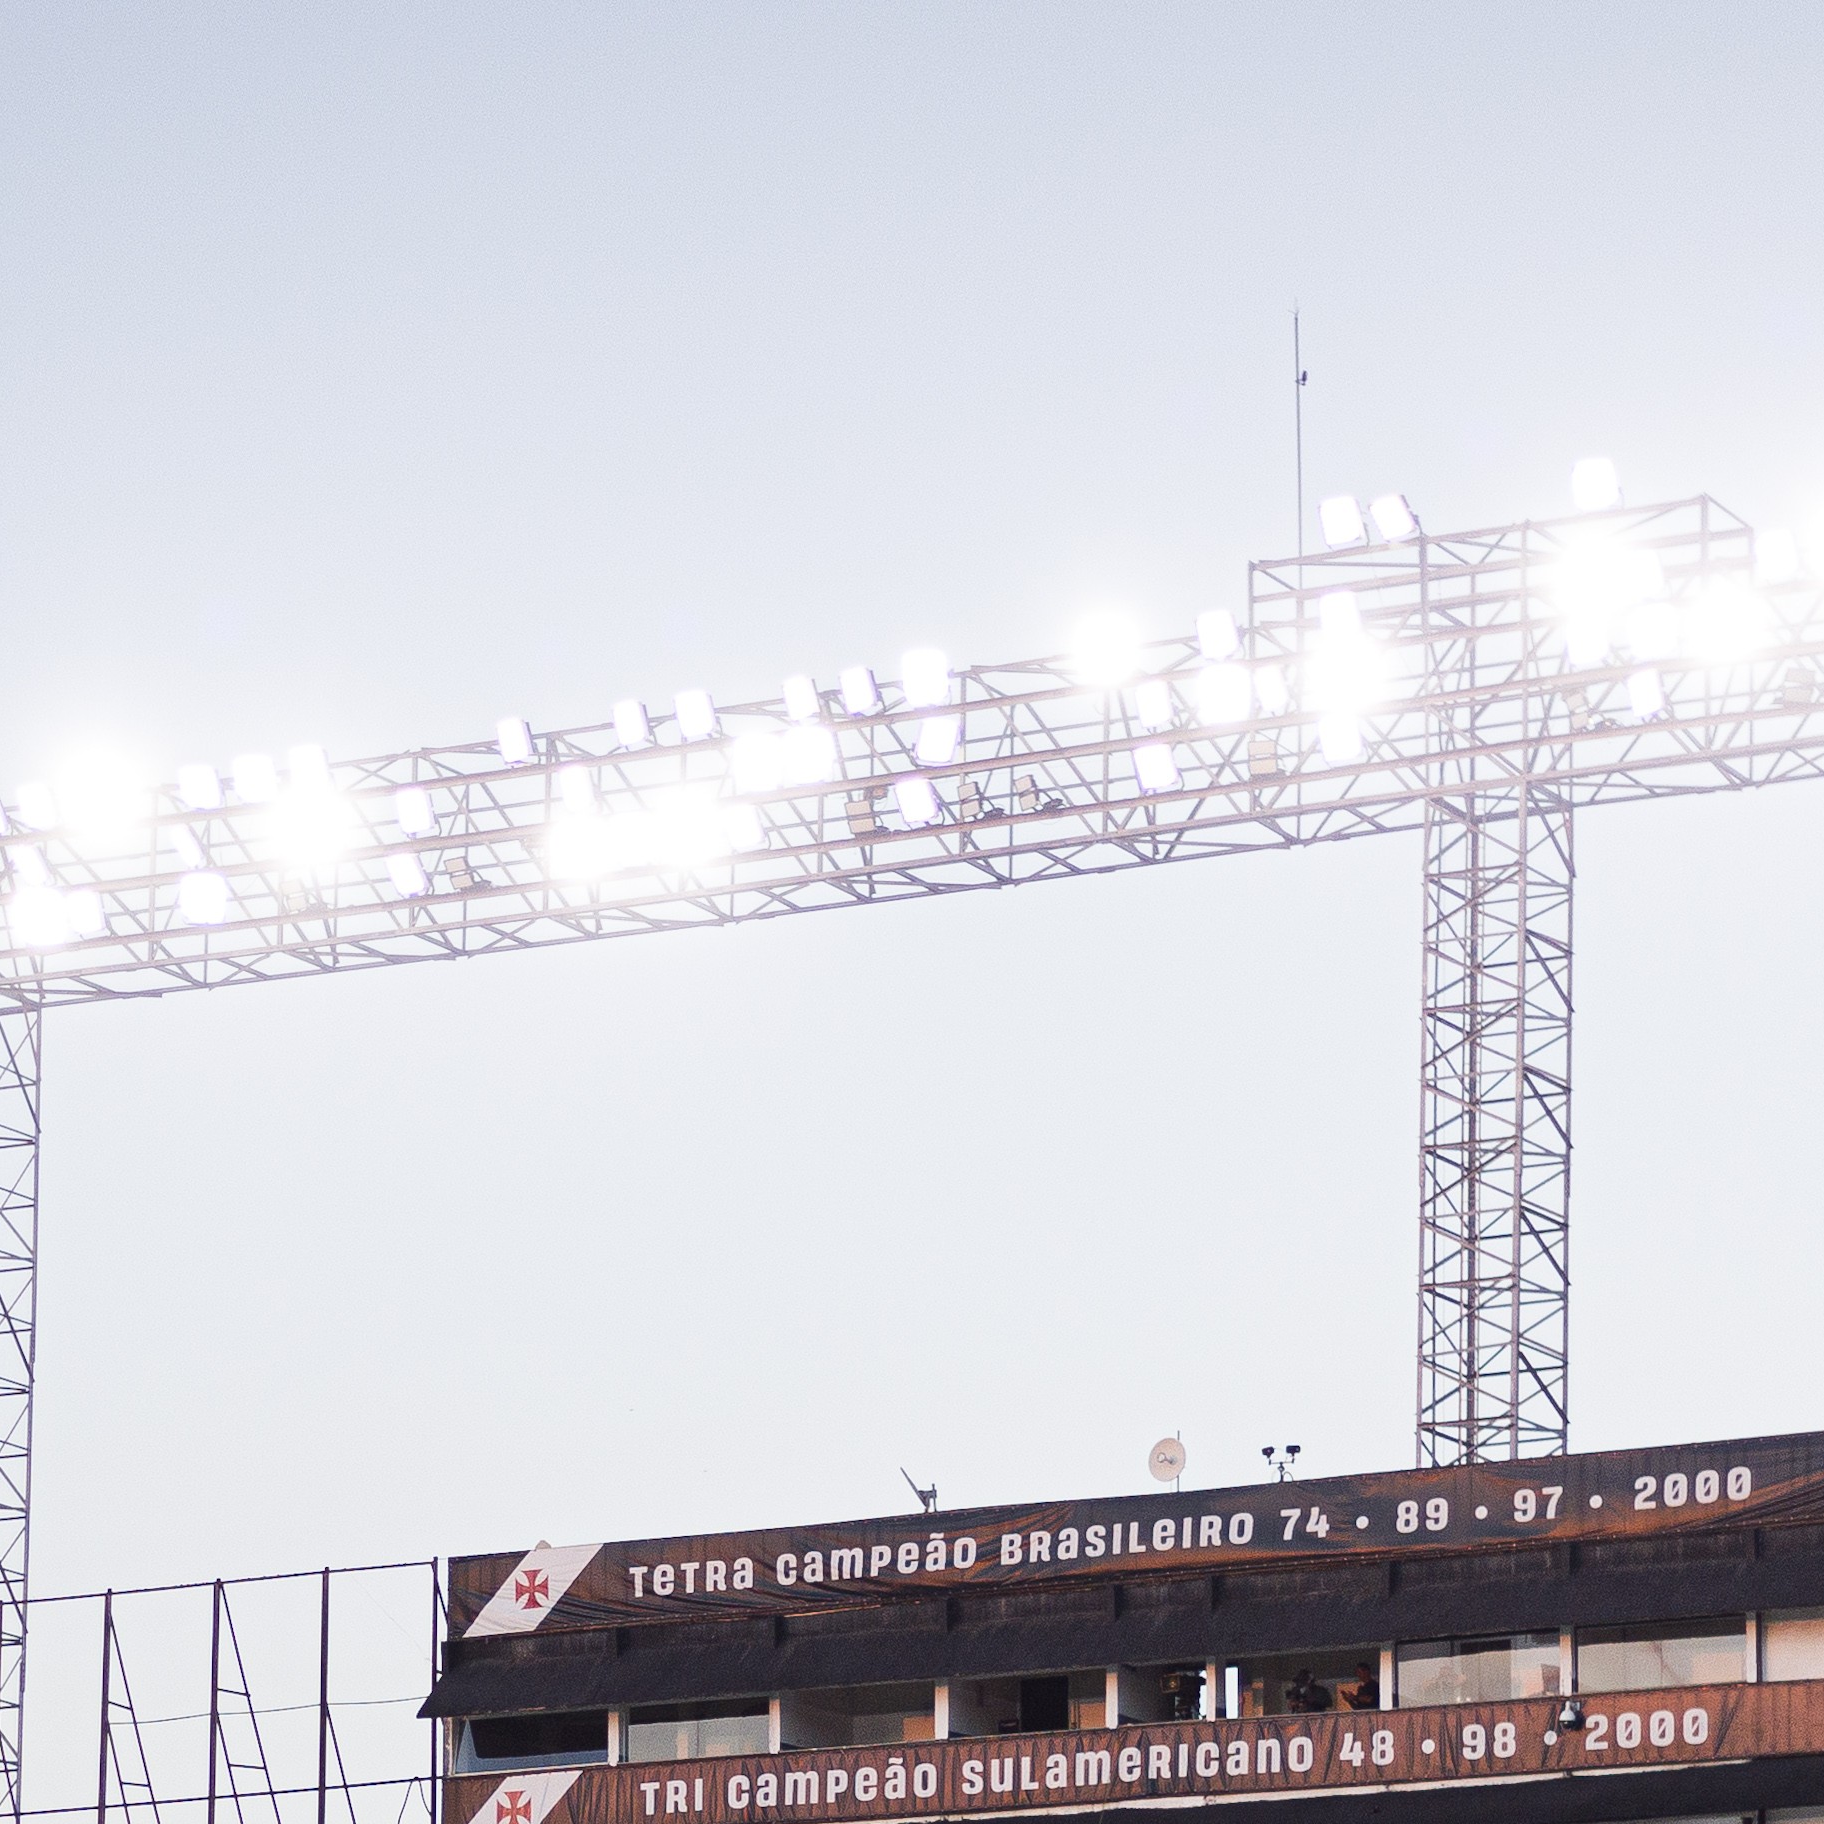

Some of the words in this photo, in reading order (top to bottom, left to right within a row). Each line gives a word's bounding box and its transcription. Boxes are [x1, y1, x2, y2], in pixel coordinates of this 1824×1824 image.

[1280, 1507, 1330, 1540] 74
[1396, 1497, 1449, 1534] 89
[1513, 1485, 1564, 1523] 97
[1634, 1466, 1752, 1511] 2000
[640, 1778, 703, 1815] TRI
[1339, 1730, 1395, 1767] 48
[1462, 1721, 1518, 1761] 98
[1585, 1708, 1709, 1751] 2000
